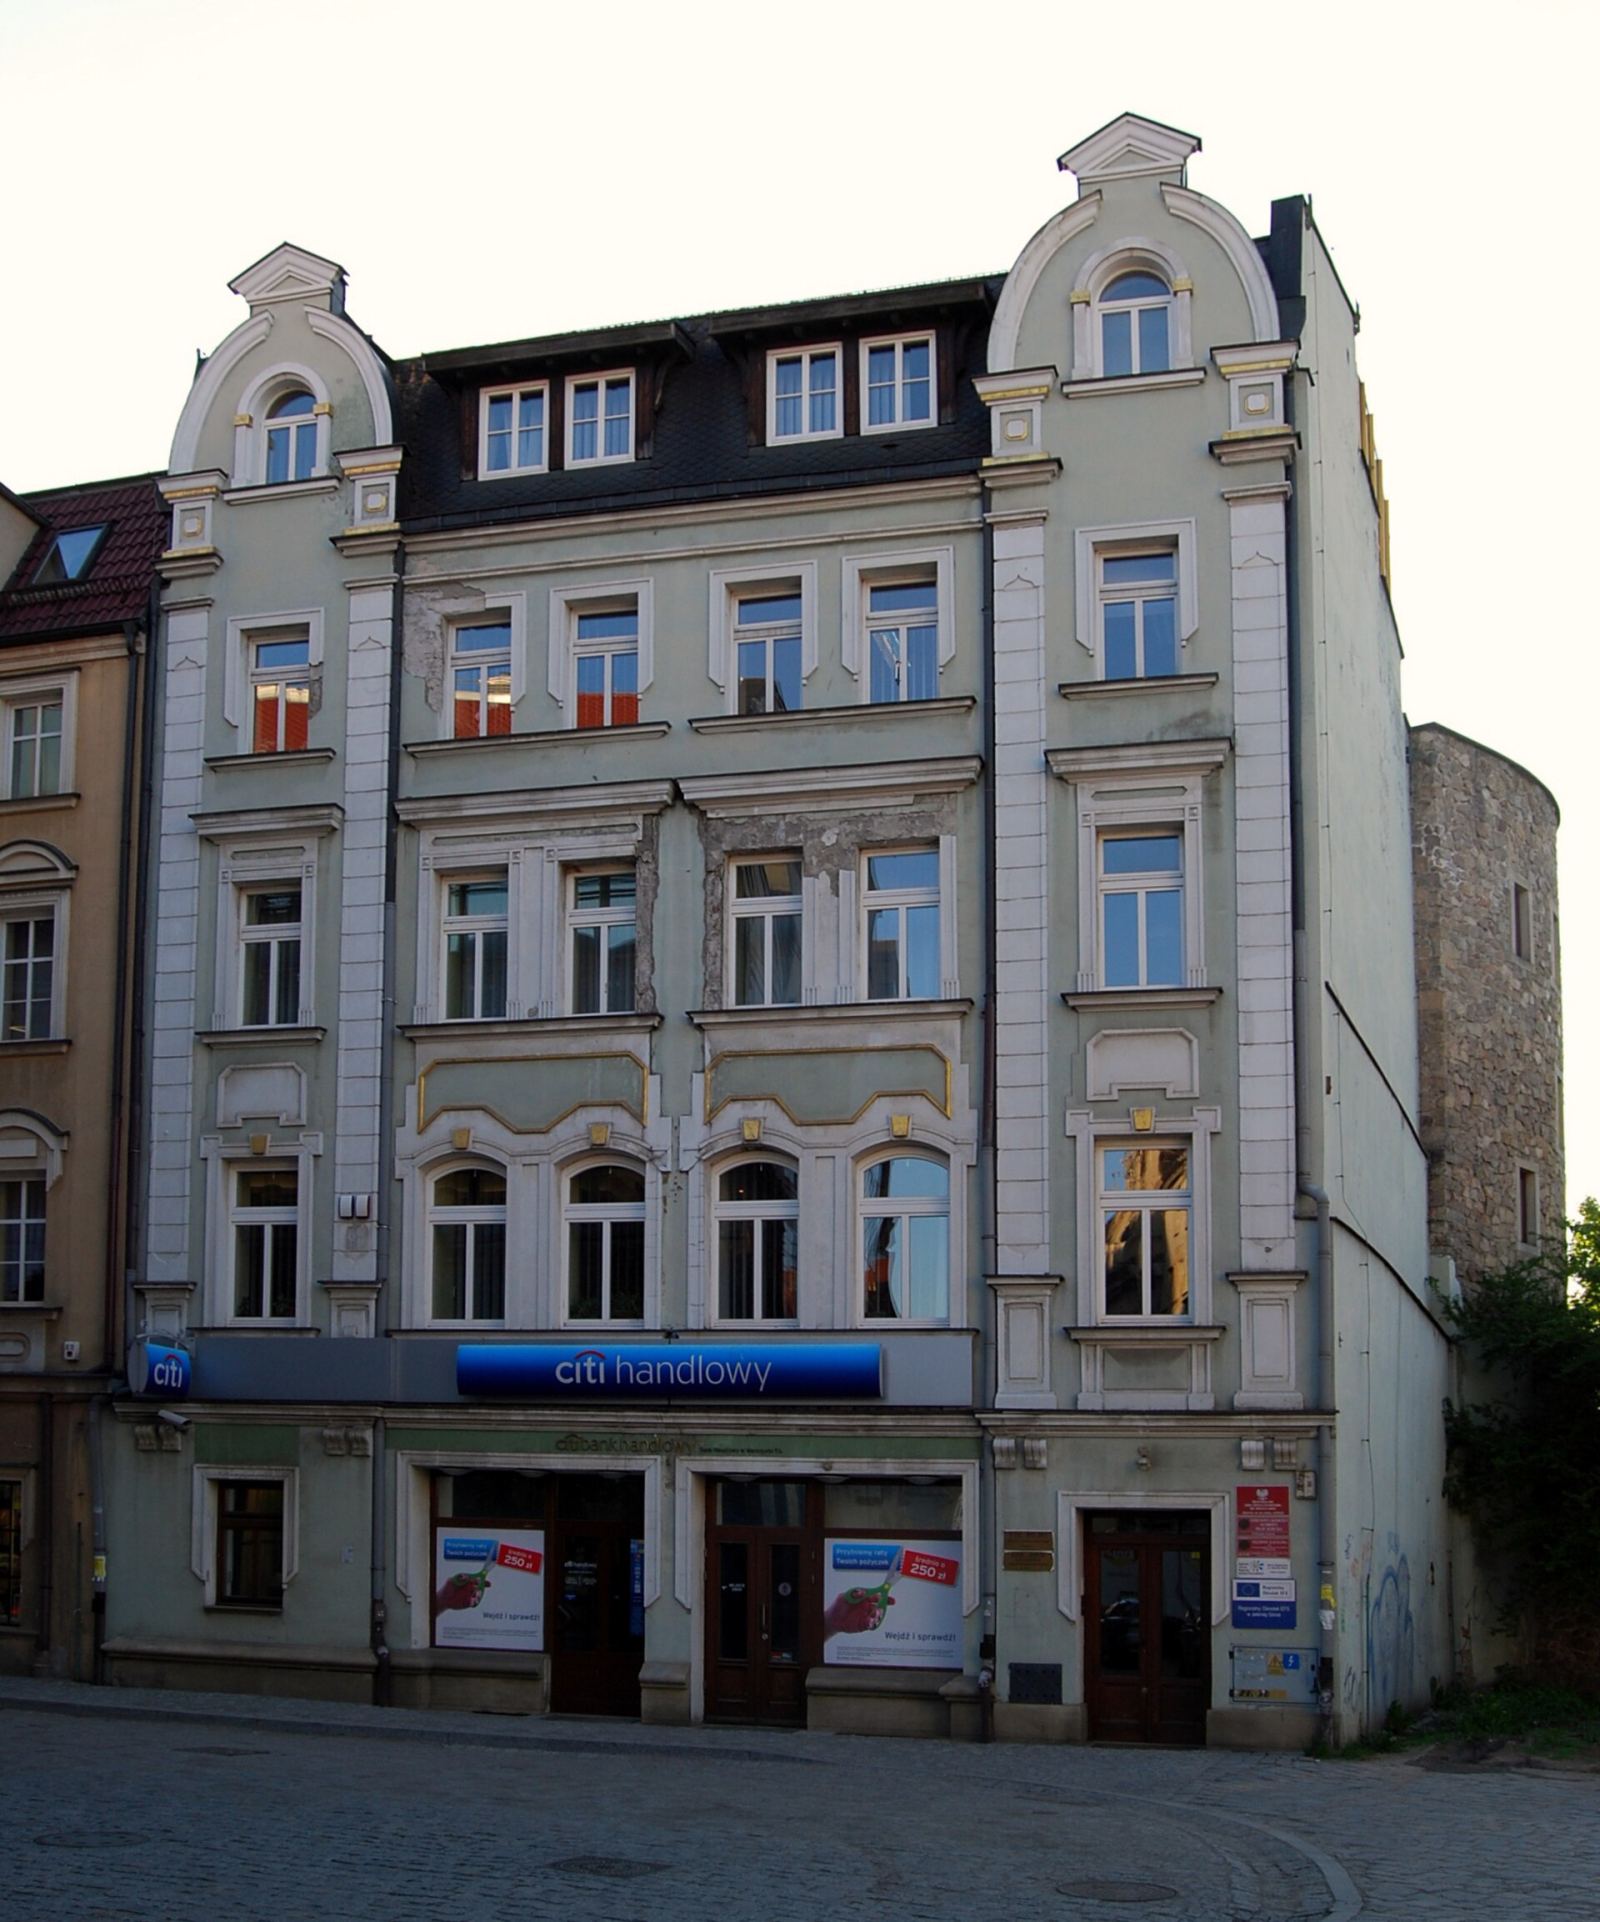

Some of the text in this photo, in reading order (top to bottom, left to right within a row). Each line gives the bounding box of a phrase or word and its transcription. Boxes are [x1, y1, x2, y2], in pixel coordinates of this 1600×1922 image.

[153, 1354, 183, 1388] citi
[555, 1351, 772, 1392] citi handlowy
[504, 1555, 525, 1567] 250
[910, 1563, 946, 1580] 250 zł
[885, 1631, 910, 1643] Wejdź
[918, 1632, 956, 1643] sprawdź!
